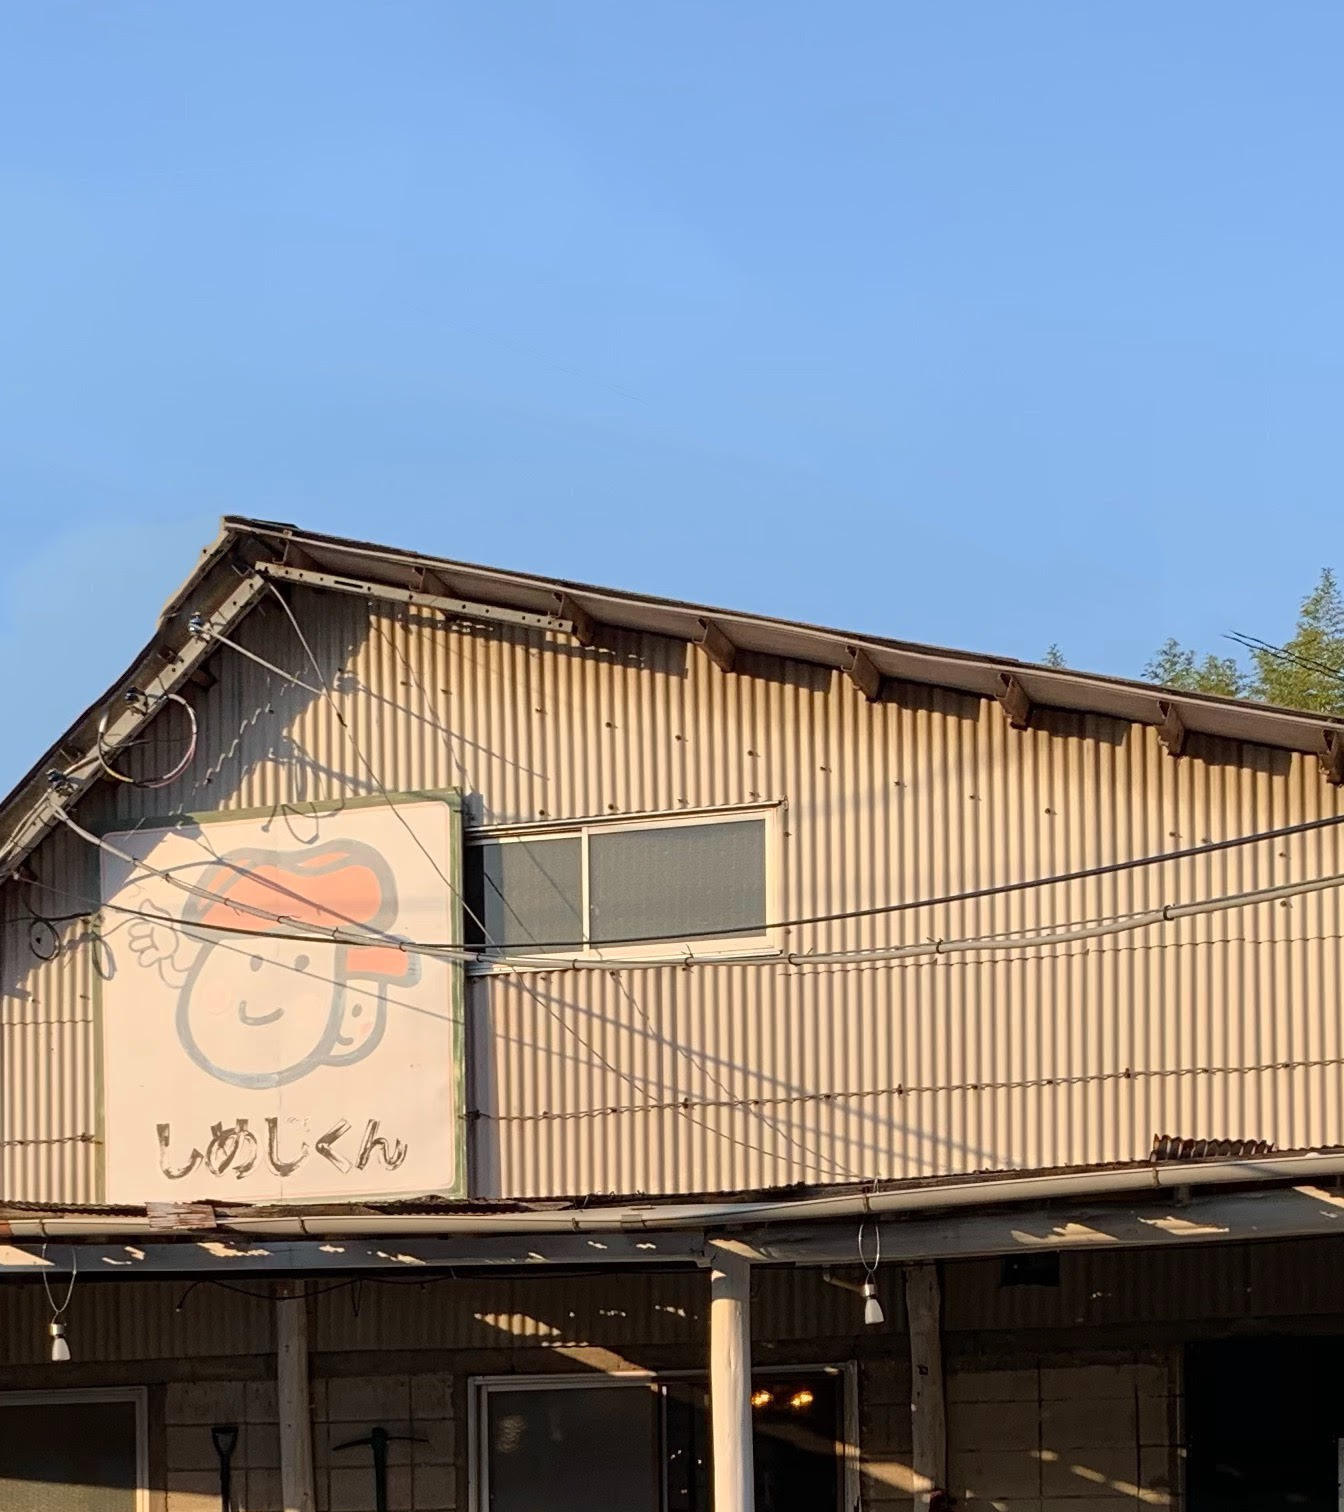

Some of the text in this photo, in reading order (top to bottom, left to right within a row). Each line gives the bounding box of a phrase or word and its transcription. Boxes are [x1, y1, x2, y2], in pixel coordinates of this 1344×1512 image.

[156, 1115, 408, 1180] しめじくん
